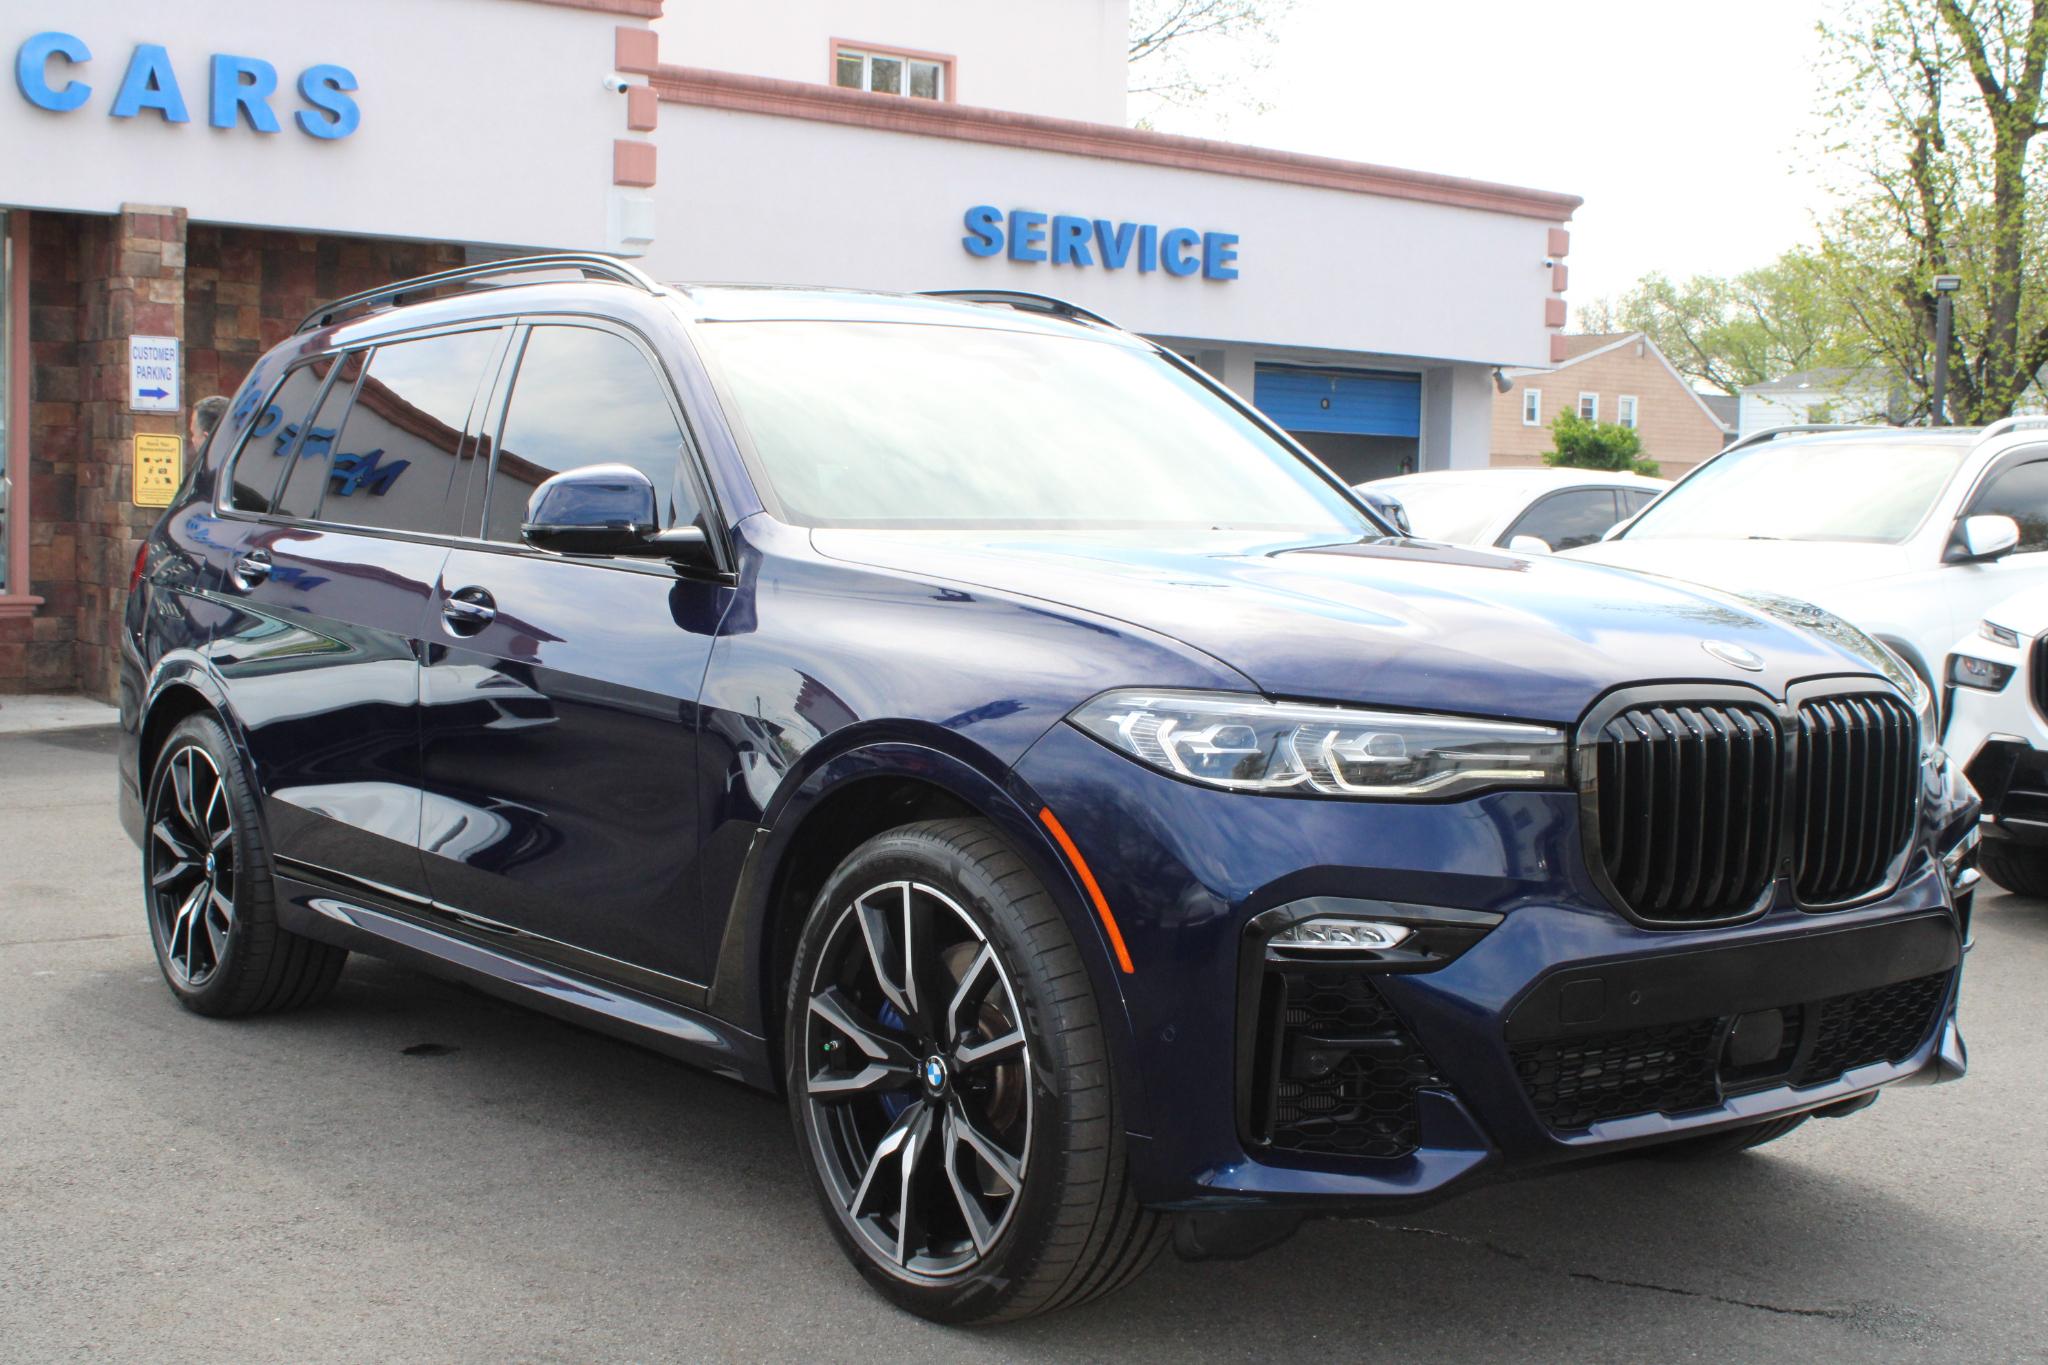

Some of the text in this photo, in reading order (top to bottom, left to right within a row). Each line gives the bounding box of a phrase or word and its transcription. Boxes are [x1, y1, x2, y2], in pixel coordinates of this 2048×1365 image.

[14, 31, 361, 139] CARS
[962, 205, 1239, 280] SERVICE
[132, 346, 175, 361] CUSTOMER
[136, 365, 172, 381] PARKING
